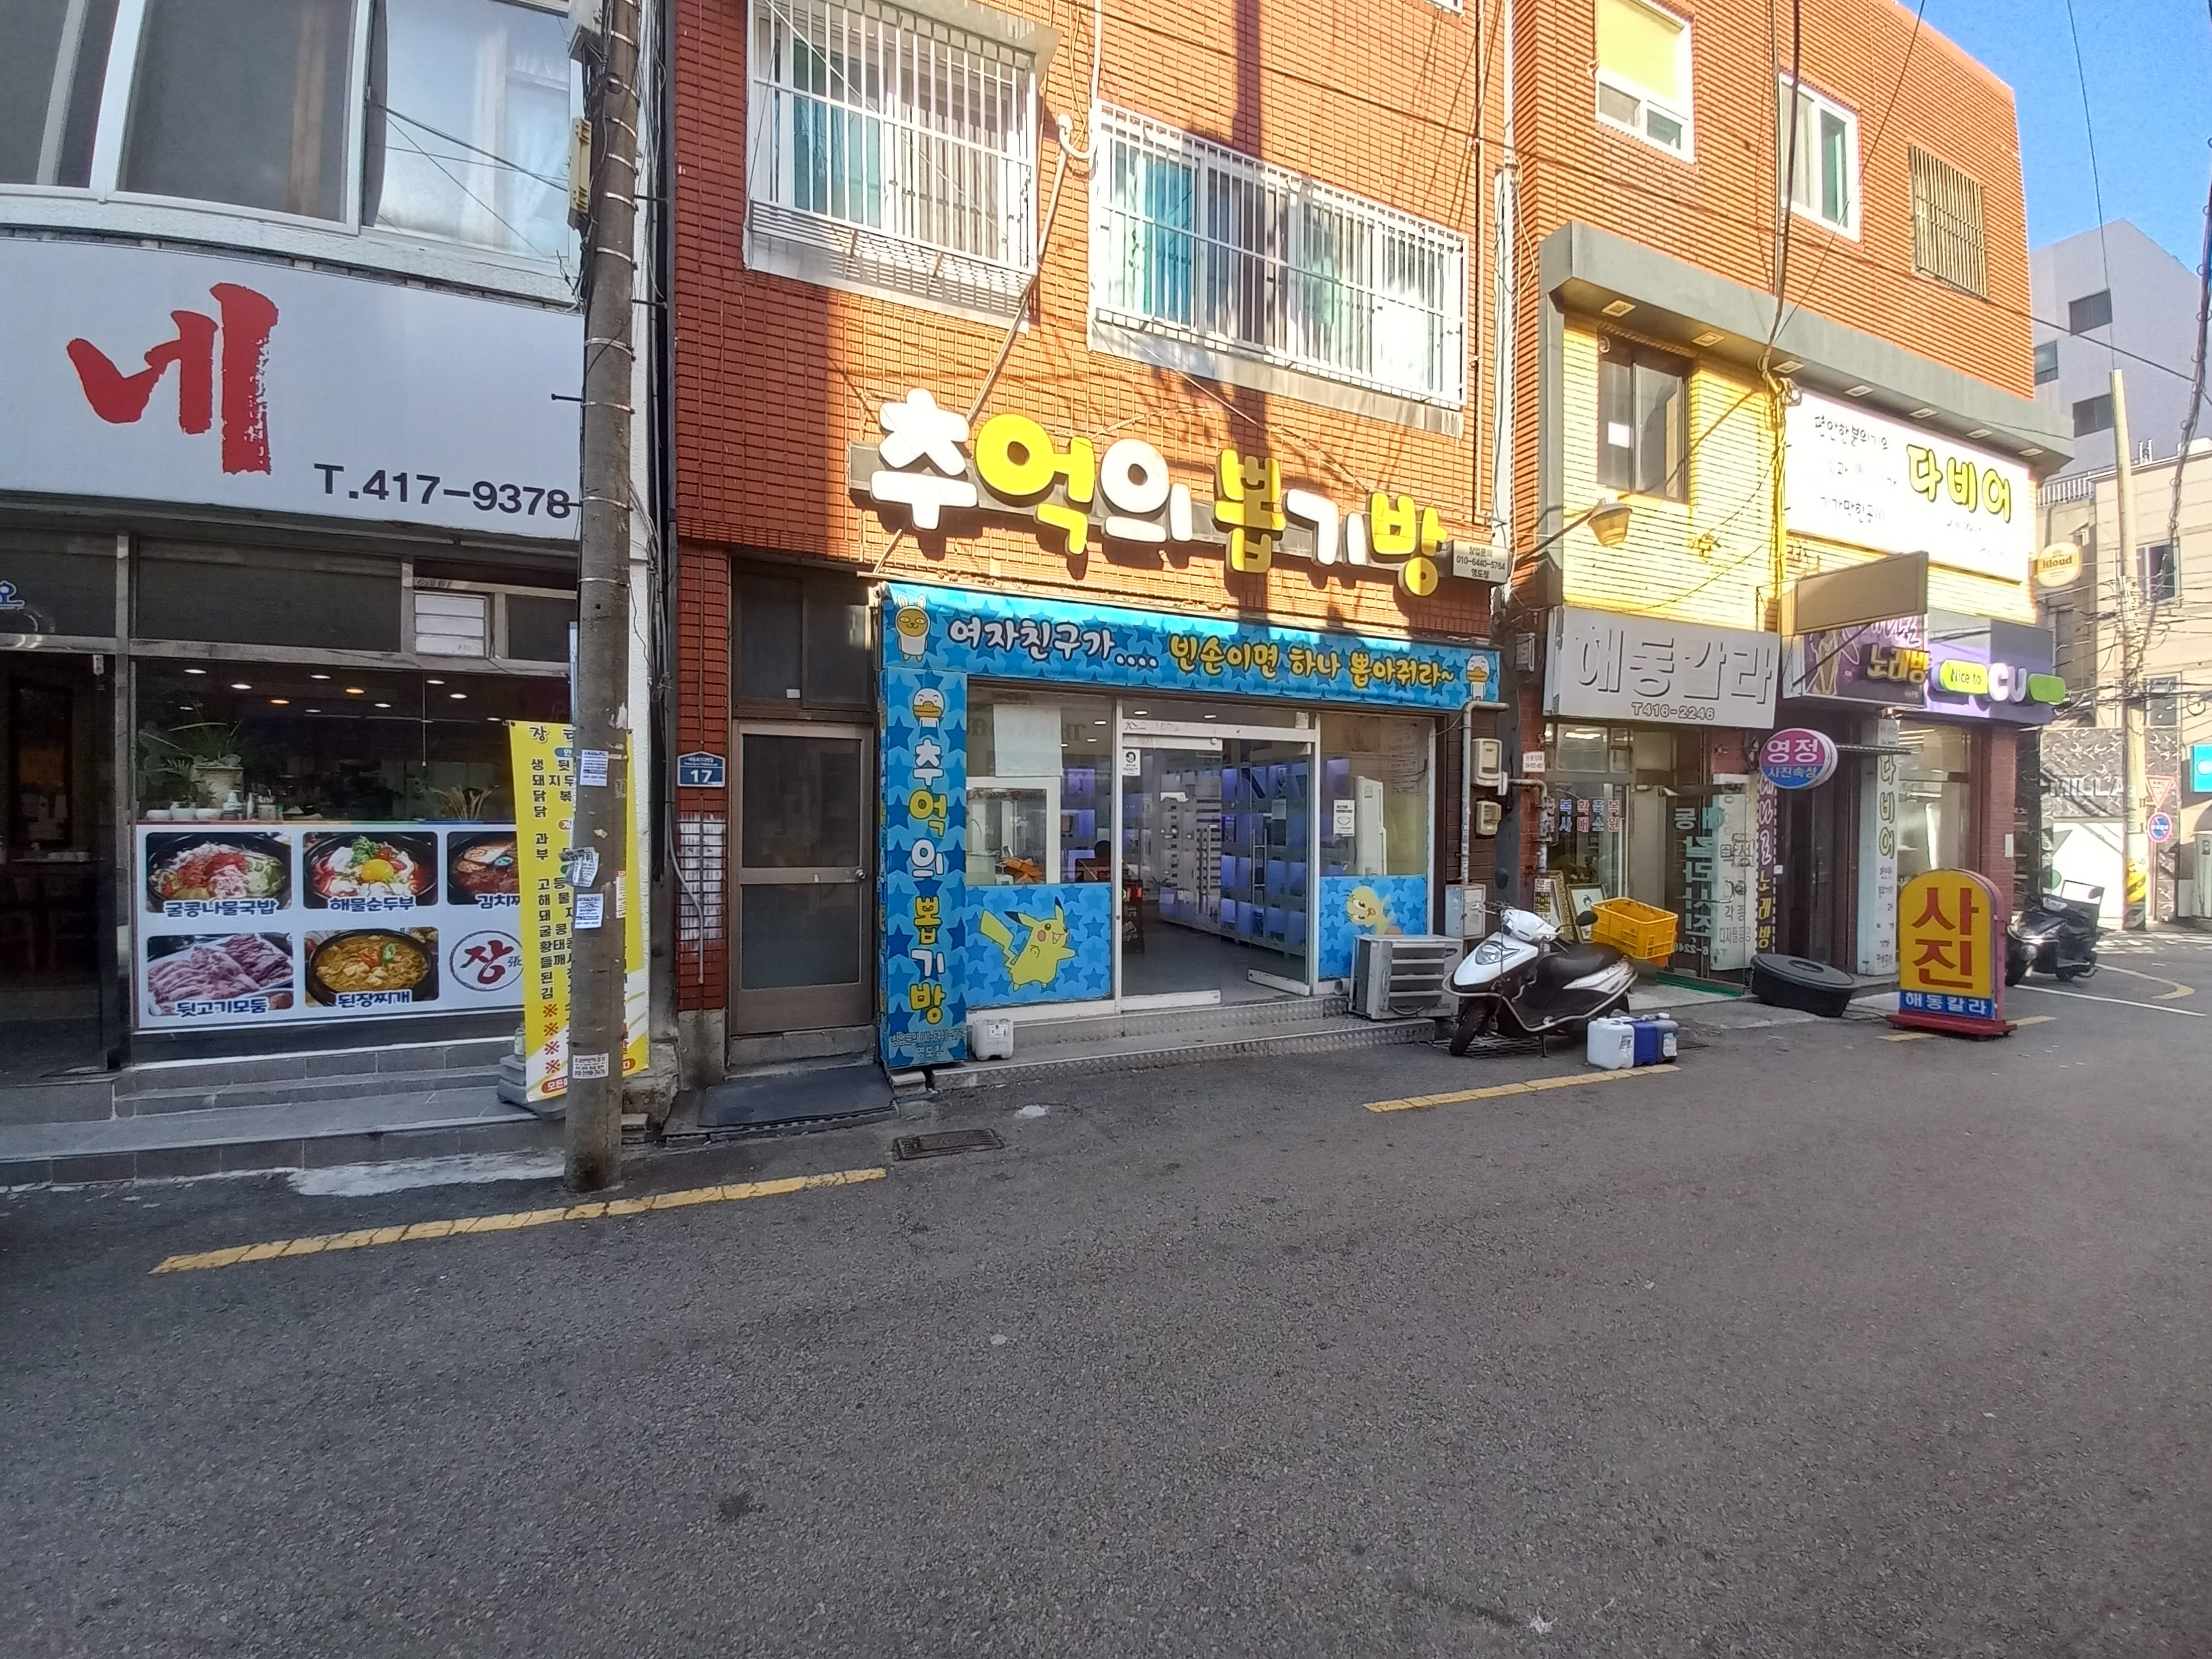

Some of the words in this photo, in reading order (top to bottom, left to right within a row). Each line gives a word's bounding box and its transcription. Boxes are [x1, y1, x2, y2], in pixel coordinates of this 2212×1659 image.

[66, 282, 279, 476] 네
[314, 464, 571, 519] T.417-9378
[871, 388, 1193, 554] 추억의
[1213, 449, 1448, 596] 뽑기방
[1906, 444, 2011, 523] 다비어
[1169, 635, 1278, 678] 빈손이면
[1288, 649, 1340, 679] 하나
[1867, 644, 1931, 684] 노래방
[1950, 668, 1969, 684] Nice
[1972, 671, 1982, 685] to
[1988, 662, 2027, 703] CU
[1631, 701, 1715, 720] T416-2246
[1767, 739, 1818, 763] 영정
[690, 769, 713, 783] 17
[1767, 766, 1818, 778] 사진속성
[908, 738, 949, 878] 추억의
[165, 900, 277, 918] 굴콩나물국밥
[329, 897, 415, 912] 해물순두부
[1758, 869, 1771, 949] 노래방
[1911, 887, 1979, 989] 사진
[460, 939, 515, 984] 장
[177, 999, 268, 1017] 뒷고기모둠
[339, 991, 410, 1008] 된장찌개
[1904, 991, 1987, 1015] 해동칼라
